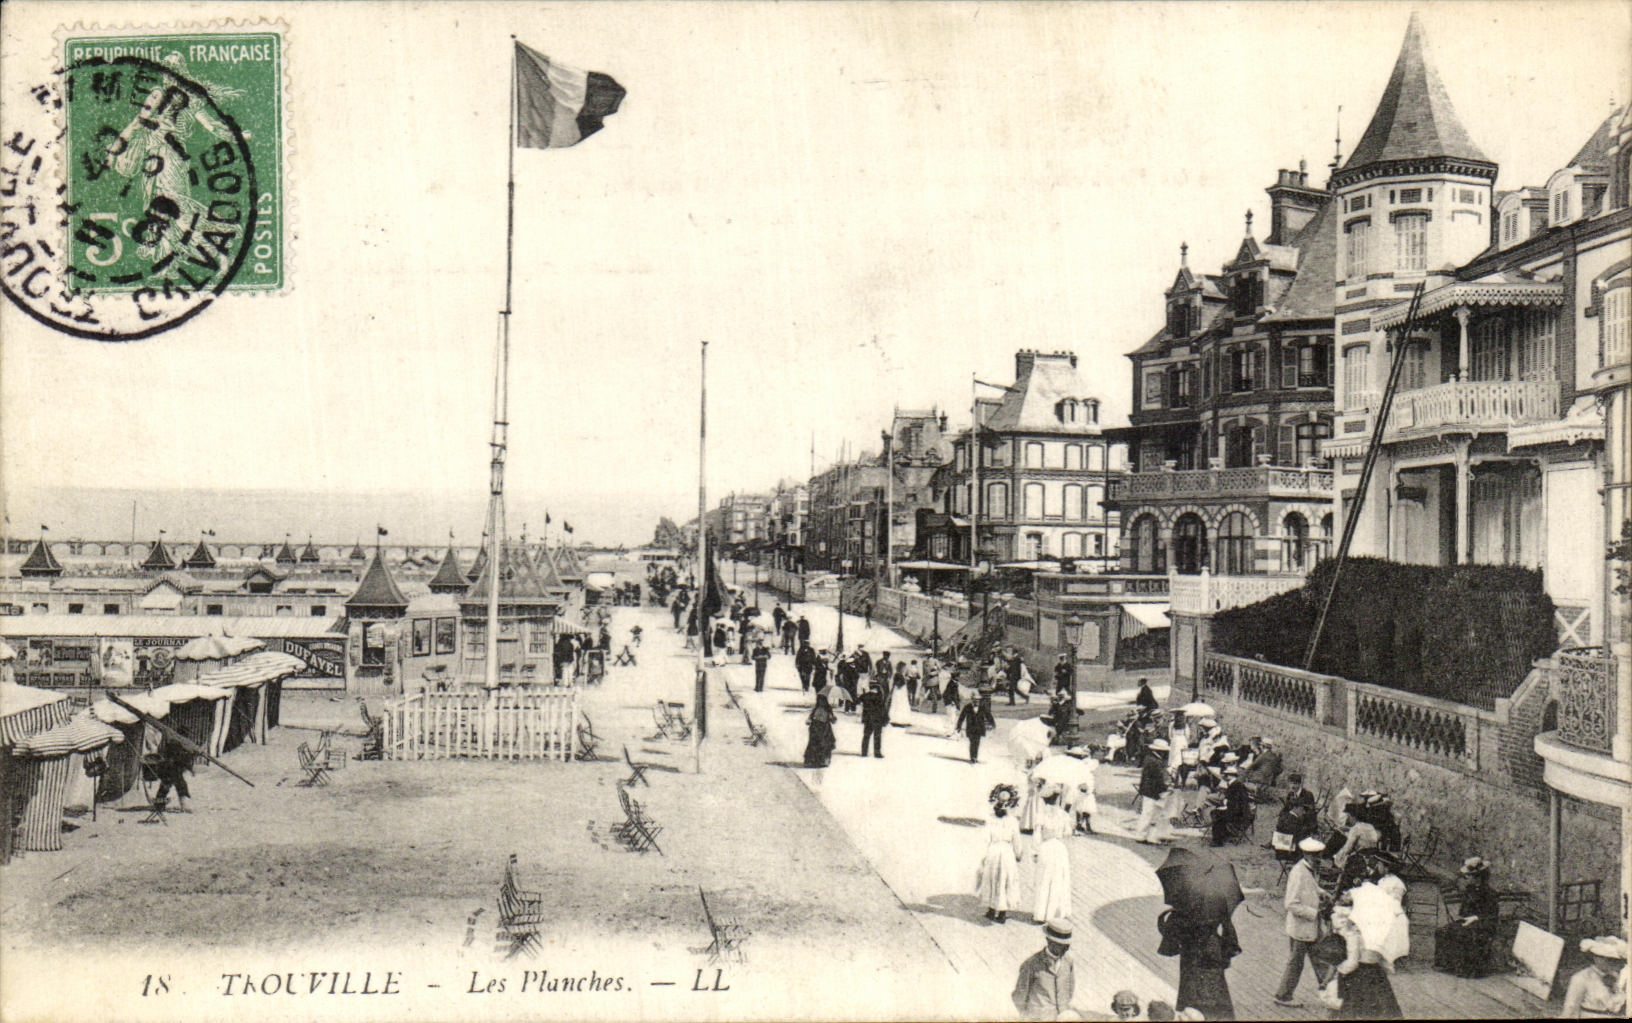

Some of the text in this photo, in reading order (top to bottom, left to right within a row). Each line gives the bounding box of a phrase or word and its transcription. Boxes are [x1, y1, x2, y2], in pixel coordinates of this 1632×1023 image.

[188, 43, 272, 64] FRANÇAISE
[133, 140, 243, 321] CALVADOS
[253, 191, 273, 275] POSTES
[285, 640, 343, 677] DUFAYEL
